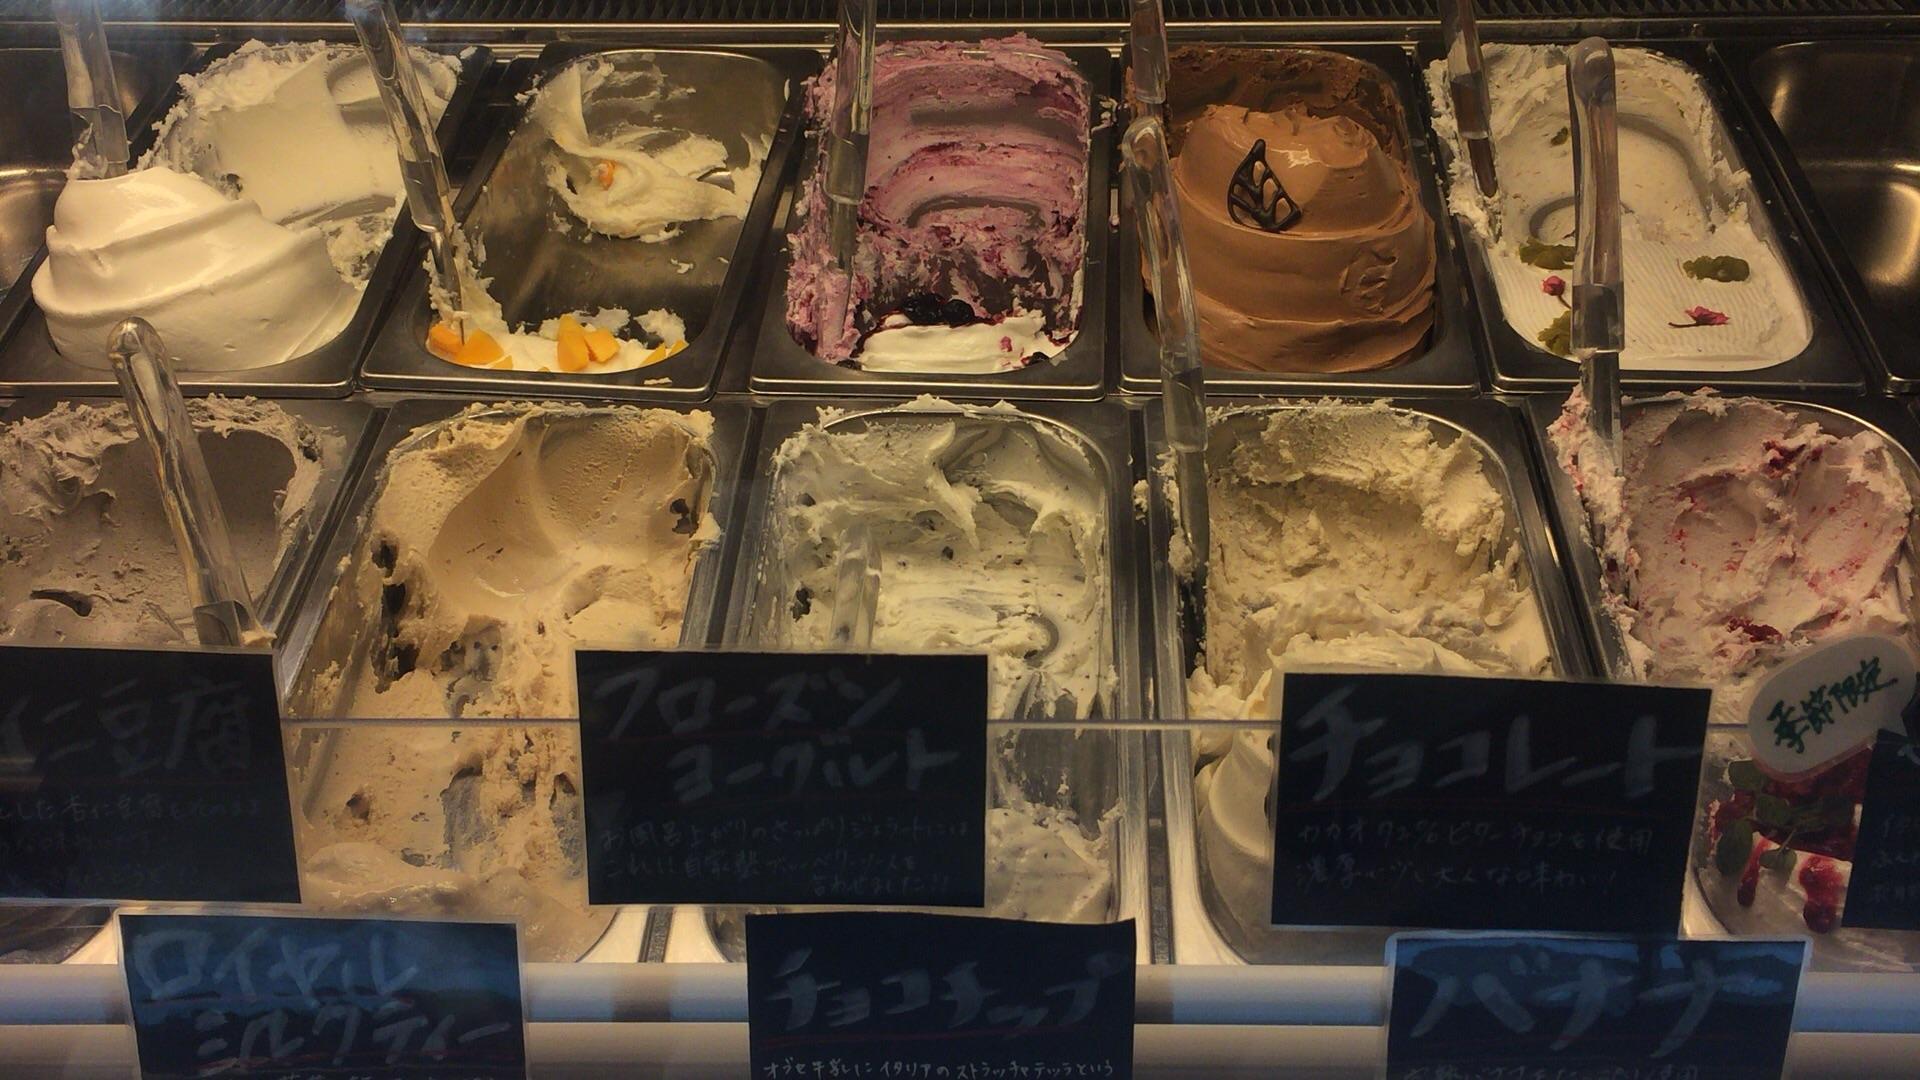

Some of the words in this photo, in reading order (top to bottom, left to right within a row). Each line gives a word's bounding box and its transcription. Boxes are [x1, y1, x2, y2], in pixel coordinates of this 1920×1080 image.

[593, 667, 903, 741] フローズン
[1288, 684, 1702, 803] チョコレート
[1766, 656, 1899, 754] 季節限定
[665, 727, 961, 804] ヨーグルト
[132, 926, 419, 1009] ロイヤル
[763, 947, 1131, 1039] チョコチップ
[1408, 951, 1784, 1059] バナナ
[194, 1000, 513, 1077] ミルクティー
